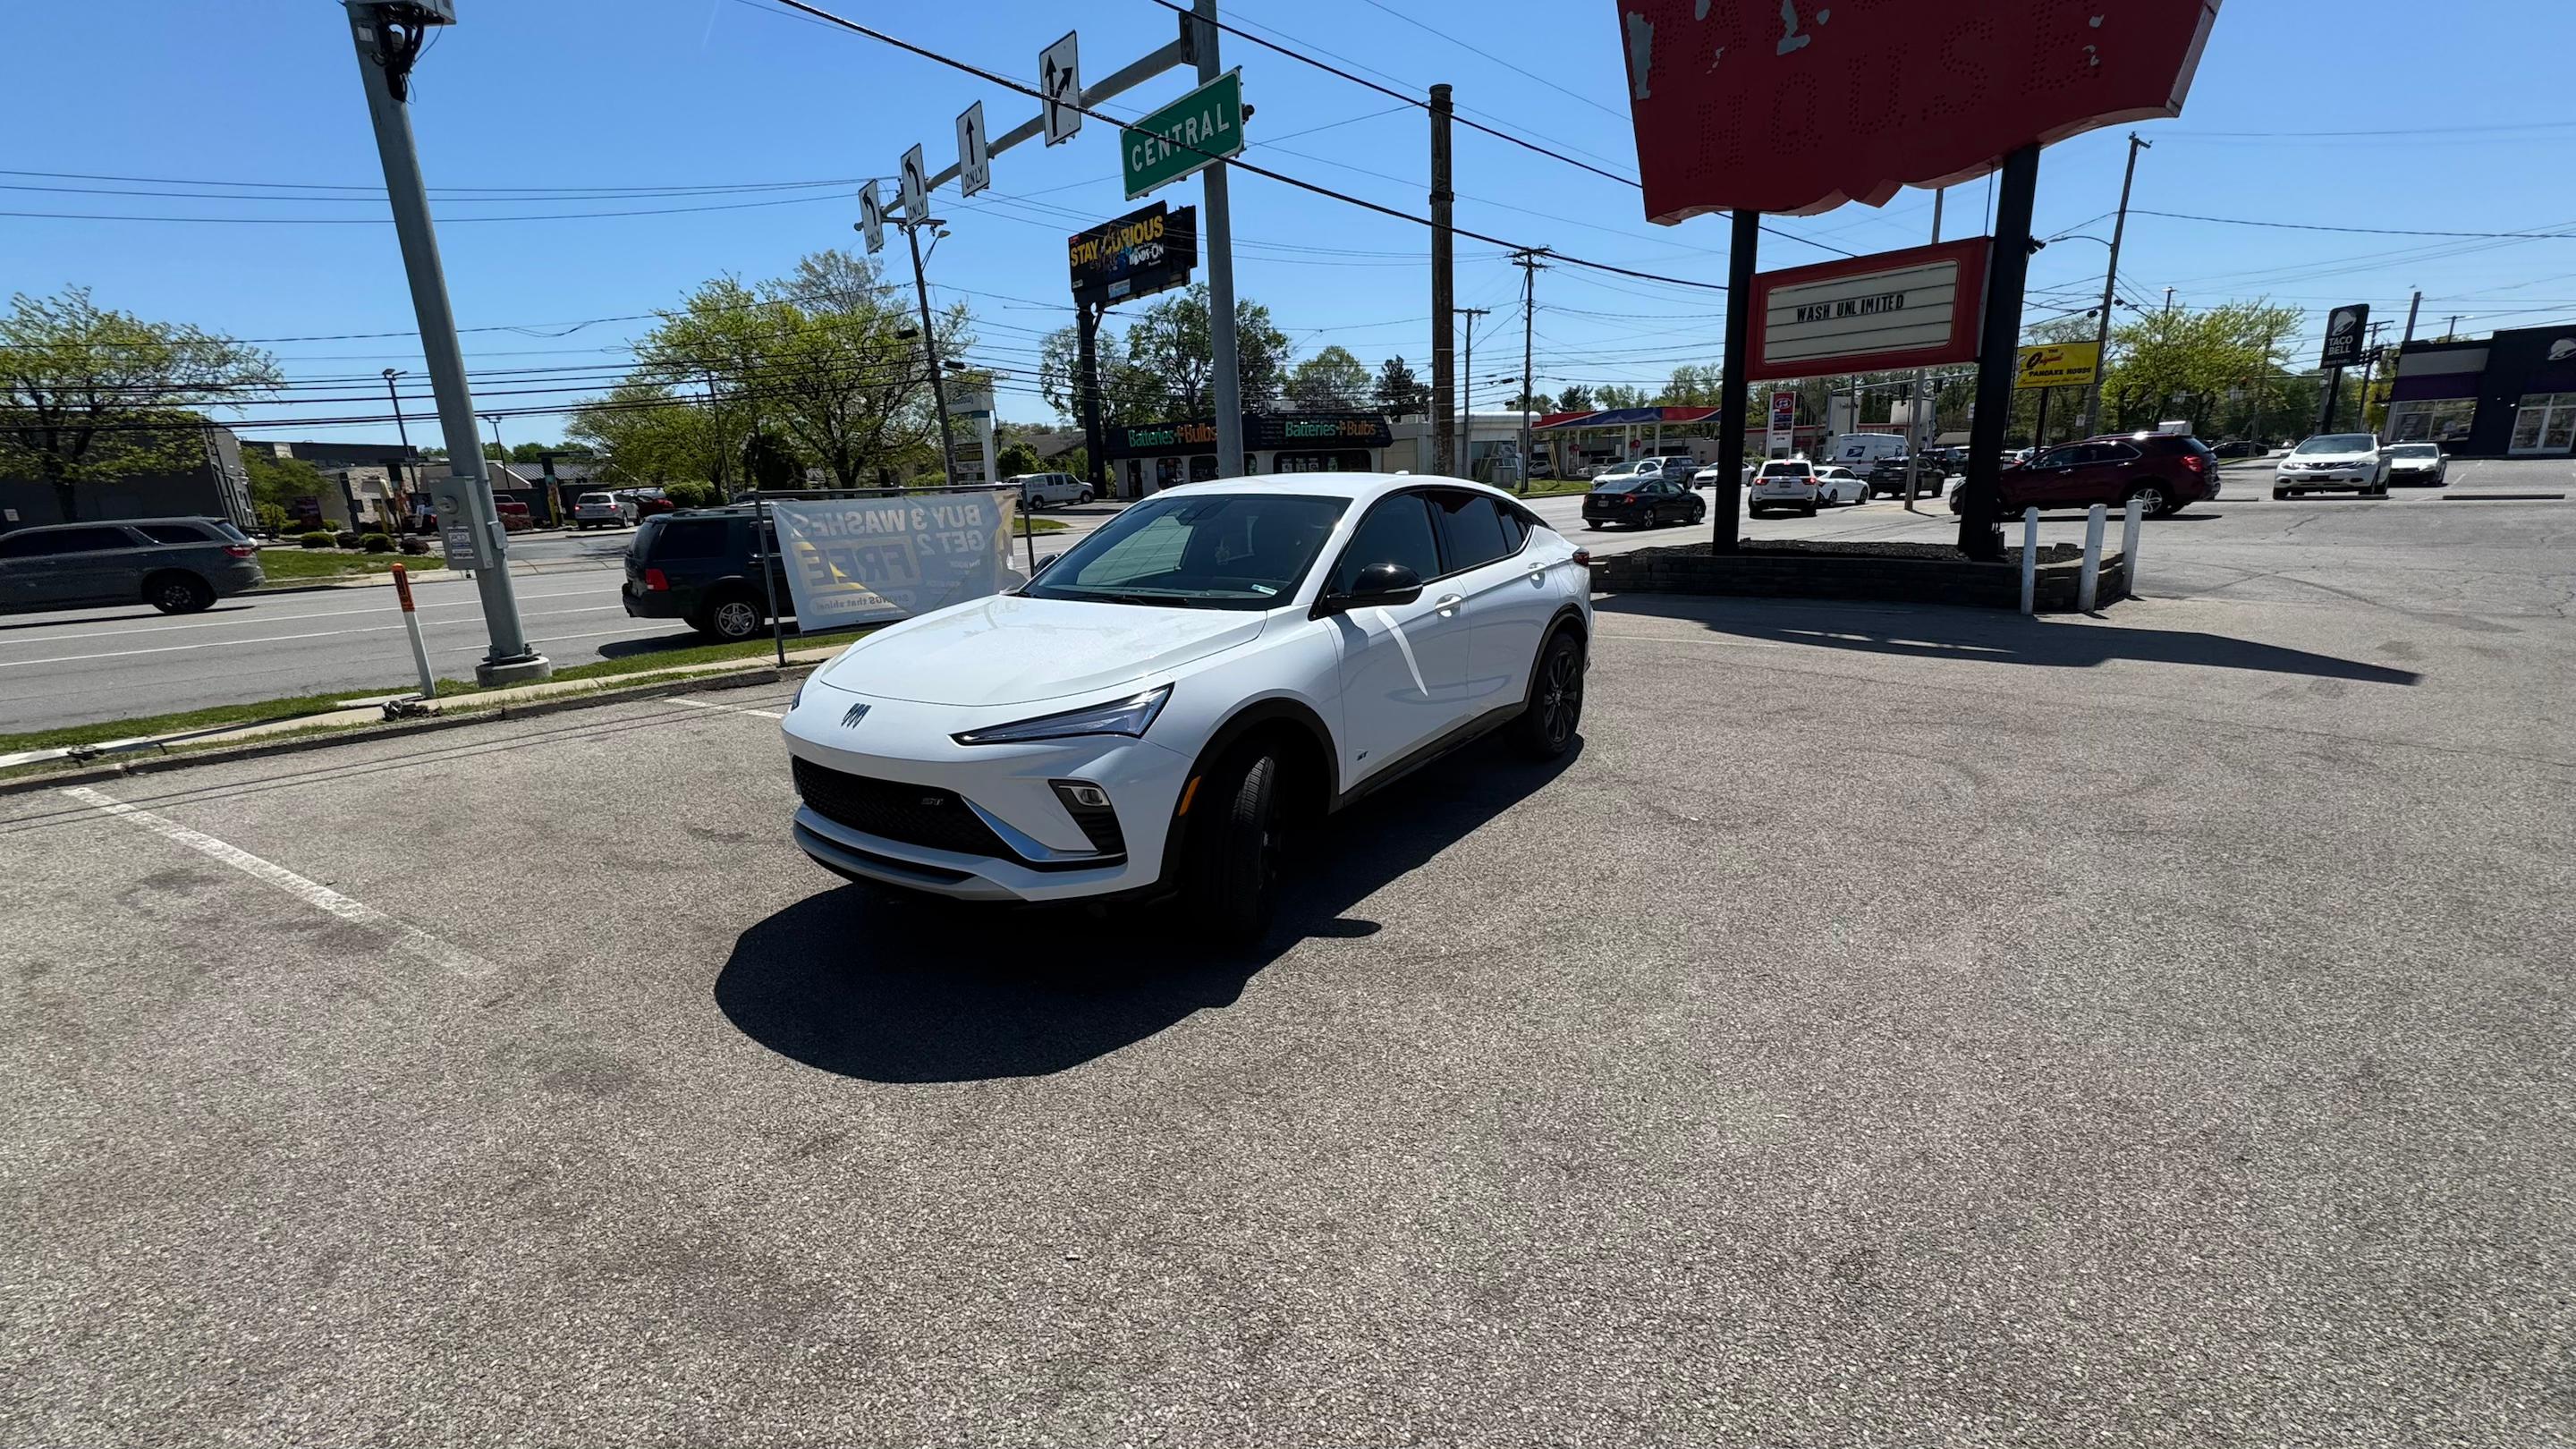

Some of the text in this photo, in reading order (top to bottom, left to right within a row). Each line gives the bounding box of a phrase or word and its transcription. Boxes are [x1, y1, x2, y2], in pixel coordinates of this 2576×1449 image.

[1131, 103, 1230, 172] CENTRAL
[965, 165, 983, 189] ONLY
[908, 199, 924, 220] ONLY
[868, 231, 880, 248] ONLY
[1071, 215, 1164, 267] STAY CURIOUS
[1797, 293, 1905, 322] WASH UNLIMITED
[2327, 335, 2353, 346] TACO
[2327, 345, 2351, 356] BELL
[2029, 369, 2063, 377] PANCAKE
[2066, 367, 2092, 375] HOUSE
[1285, 419, 1335, 436] Batteries
[1127, 428, 1174, 447] Batteries
